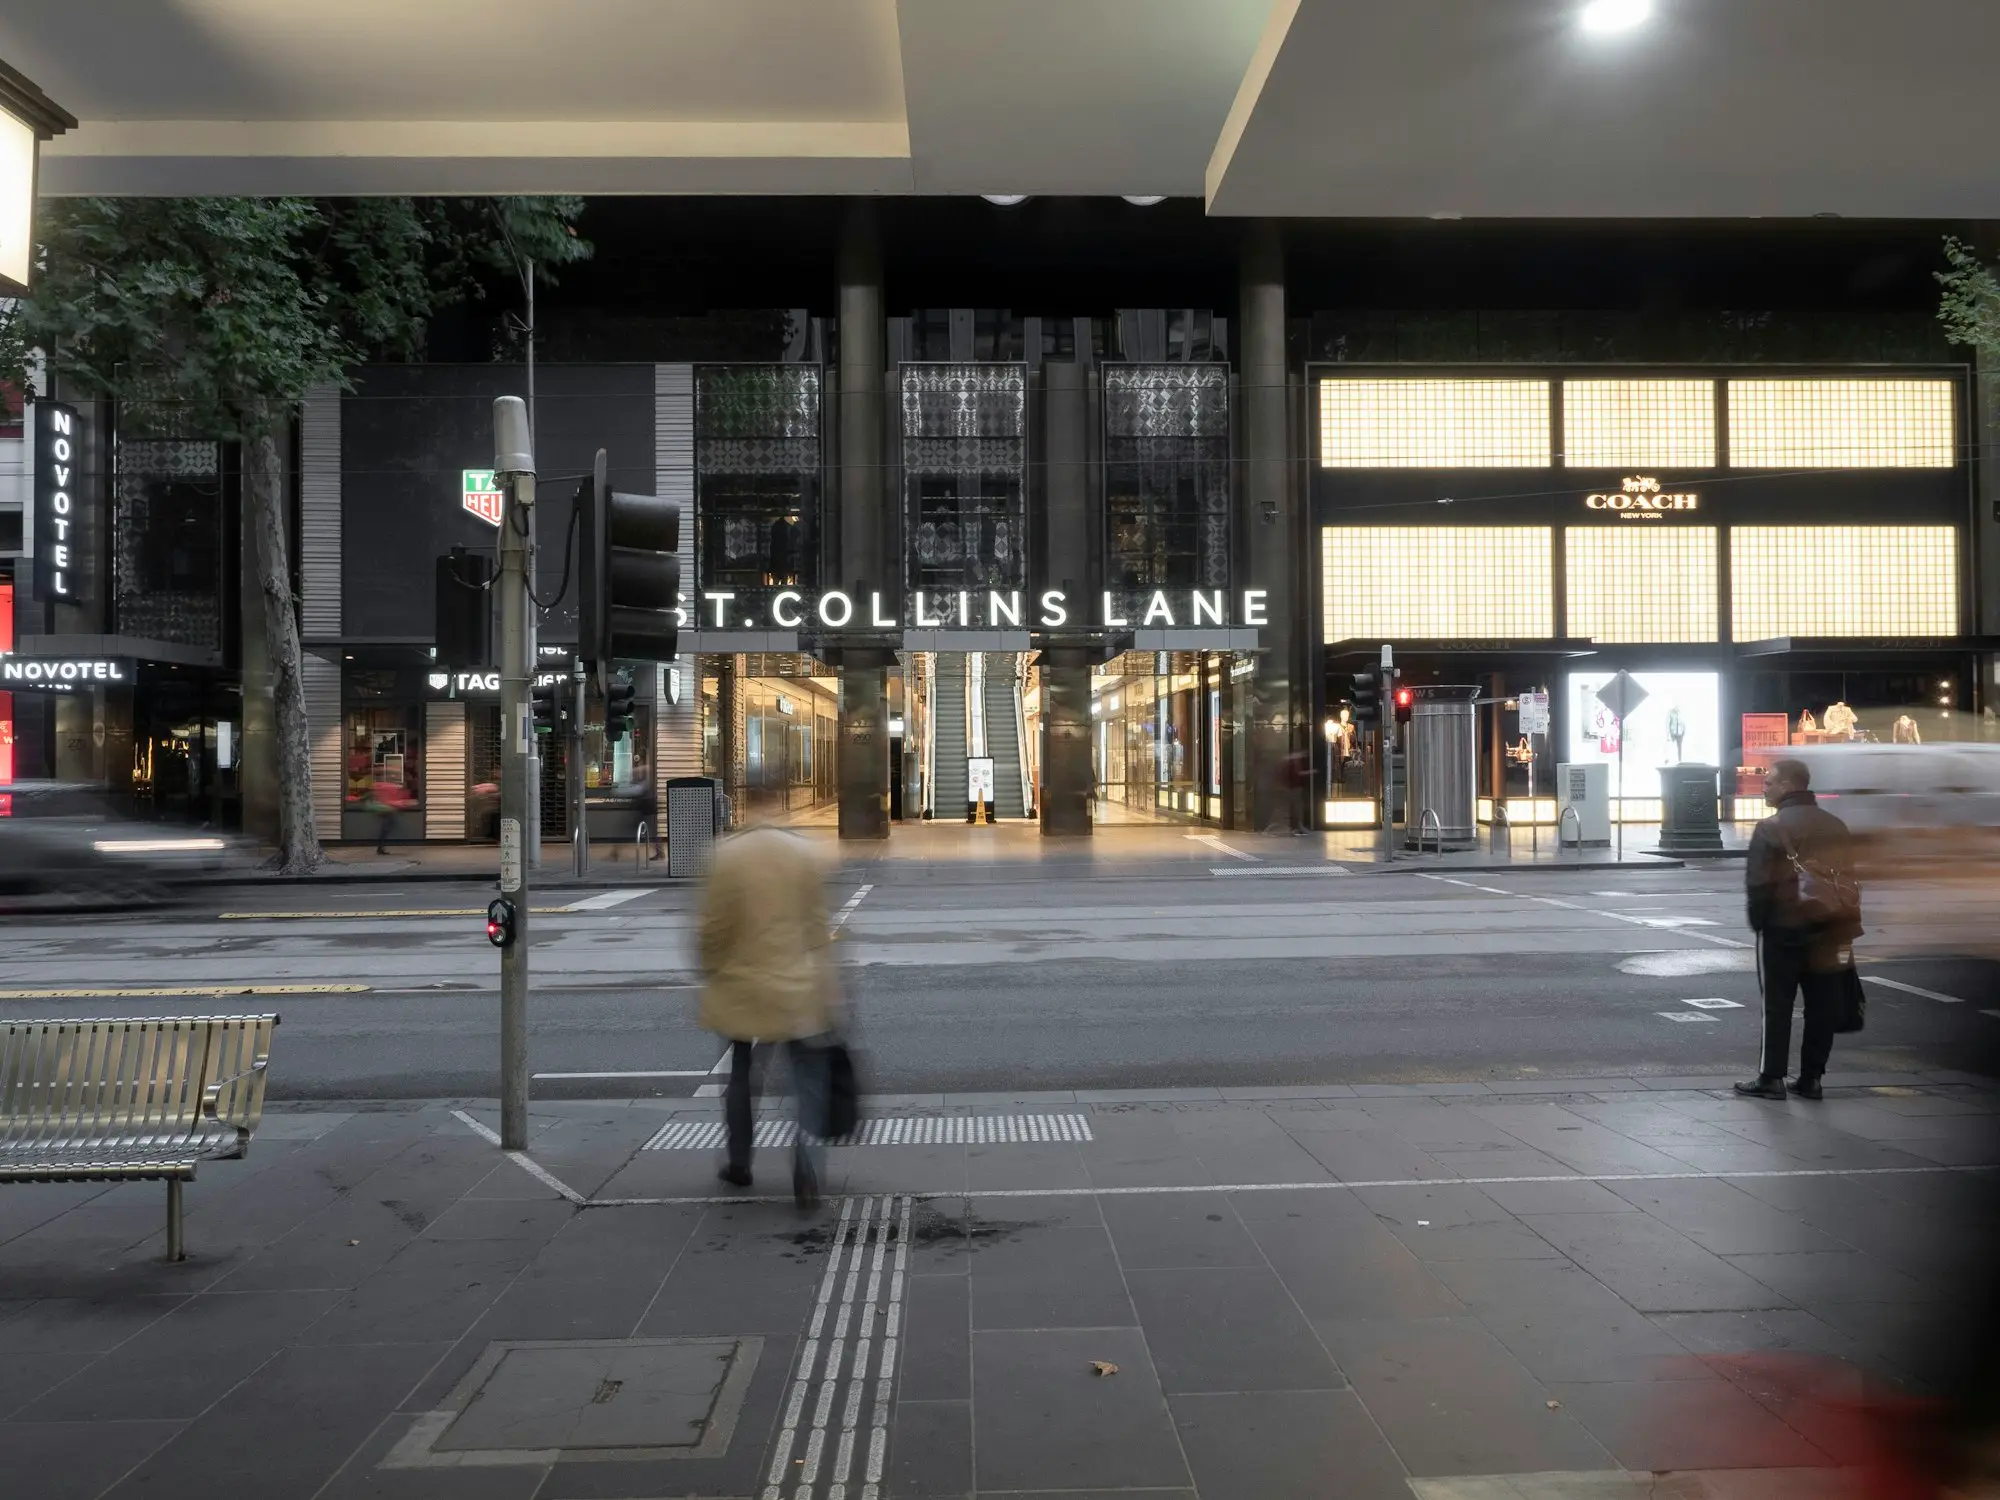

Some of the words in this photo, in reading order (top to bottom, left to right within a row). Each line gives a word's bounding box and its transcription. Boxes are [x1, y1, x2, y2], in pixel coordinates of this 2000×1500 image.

[54, 410, 70, 593] NOVOTEL
[1586, 494, 1697, 509] COACH
[1104, 590, 1268, 626] LANE
[4, 662, 123, 679] NOVOTEL
[458, 673, 500, 690] TAG
